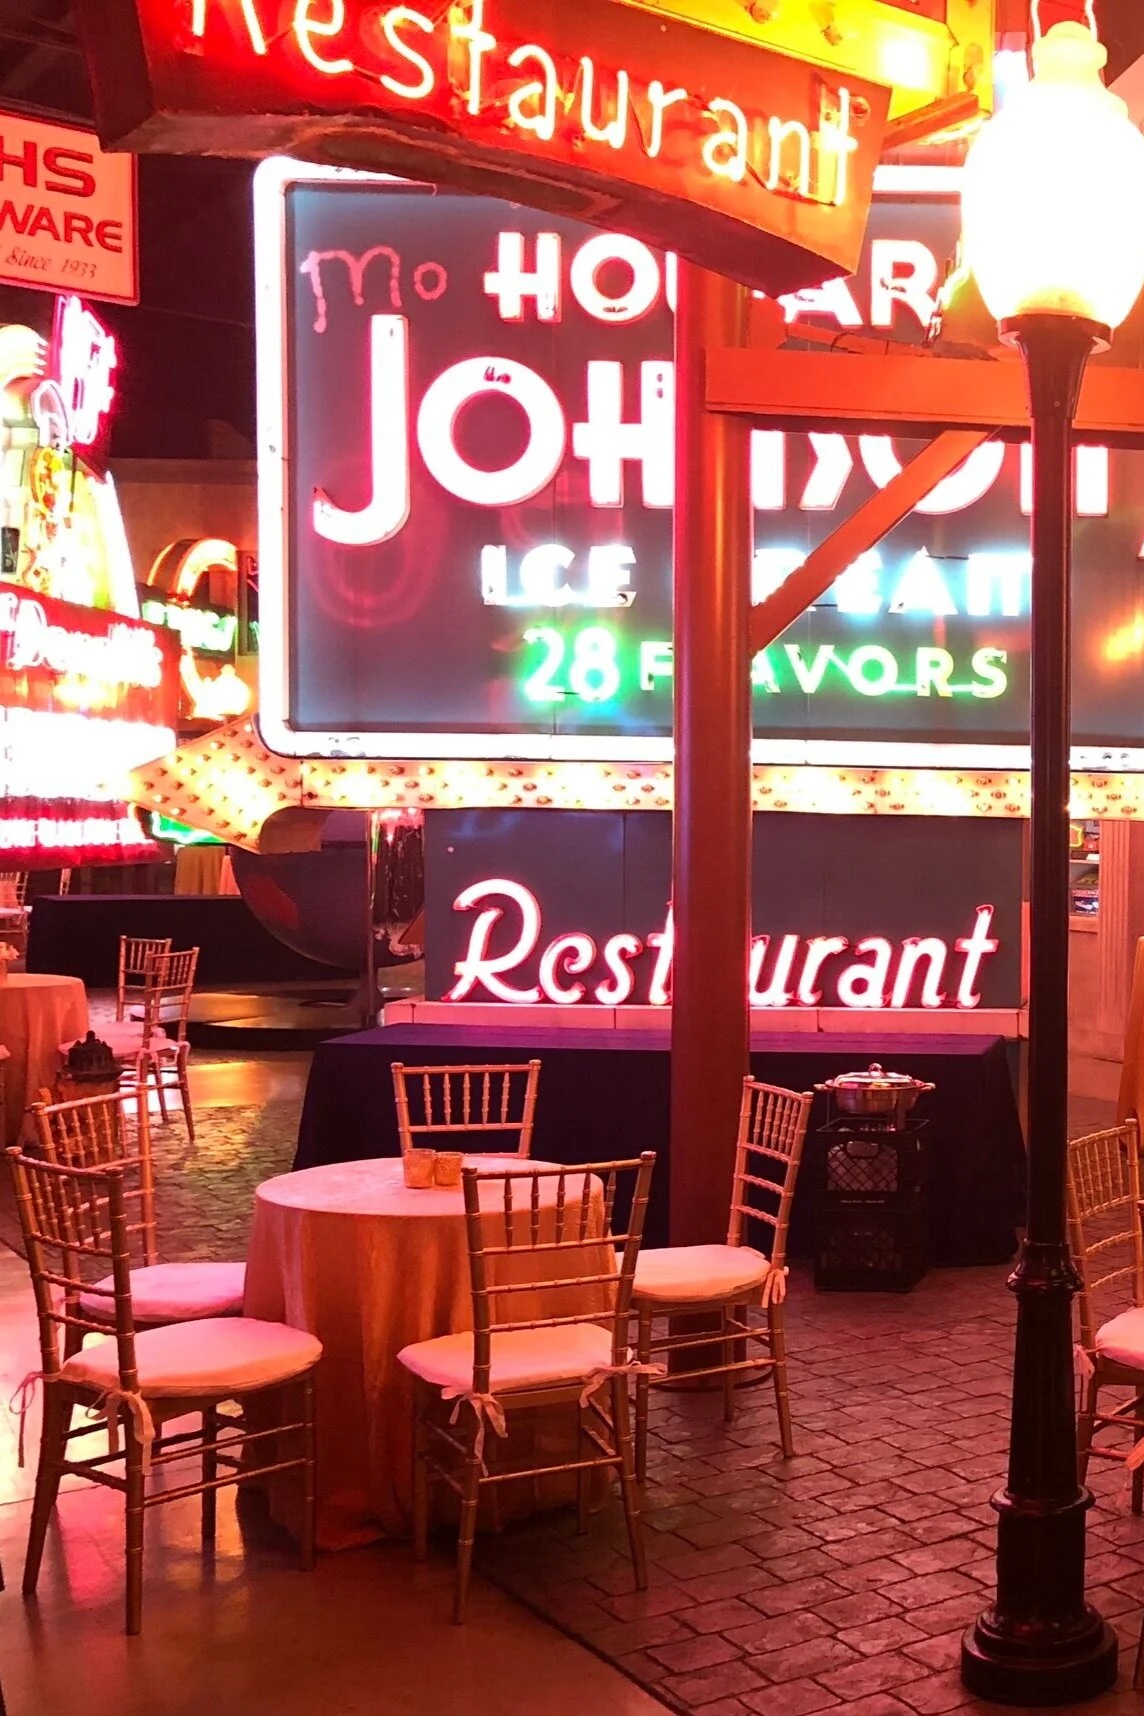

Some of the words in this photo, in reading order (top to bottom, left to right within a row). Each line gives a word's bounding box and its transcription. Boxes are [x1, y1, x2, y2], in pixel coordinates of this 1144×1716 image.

[5, 246, 52, 271] Since
[61, 257, 97, 279] 1933
[480, 544, 638, 608] ICE
[522, 626, 621, 703] 28
[640, 640, 1008, 699] FAVORS
[441, 878, 999, 1010] Resturant
